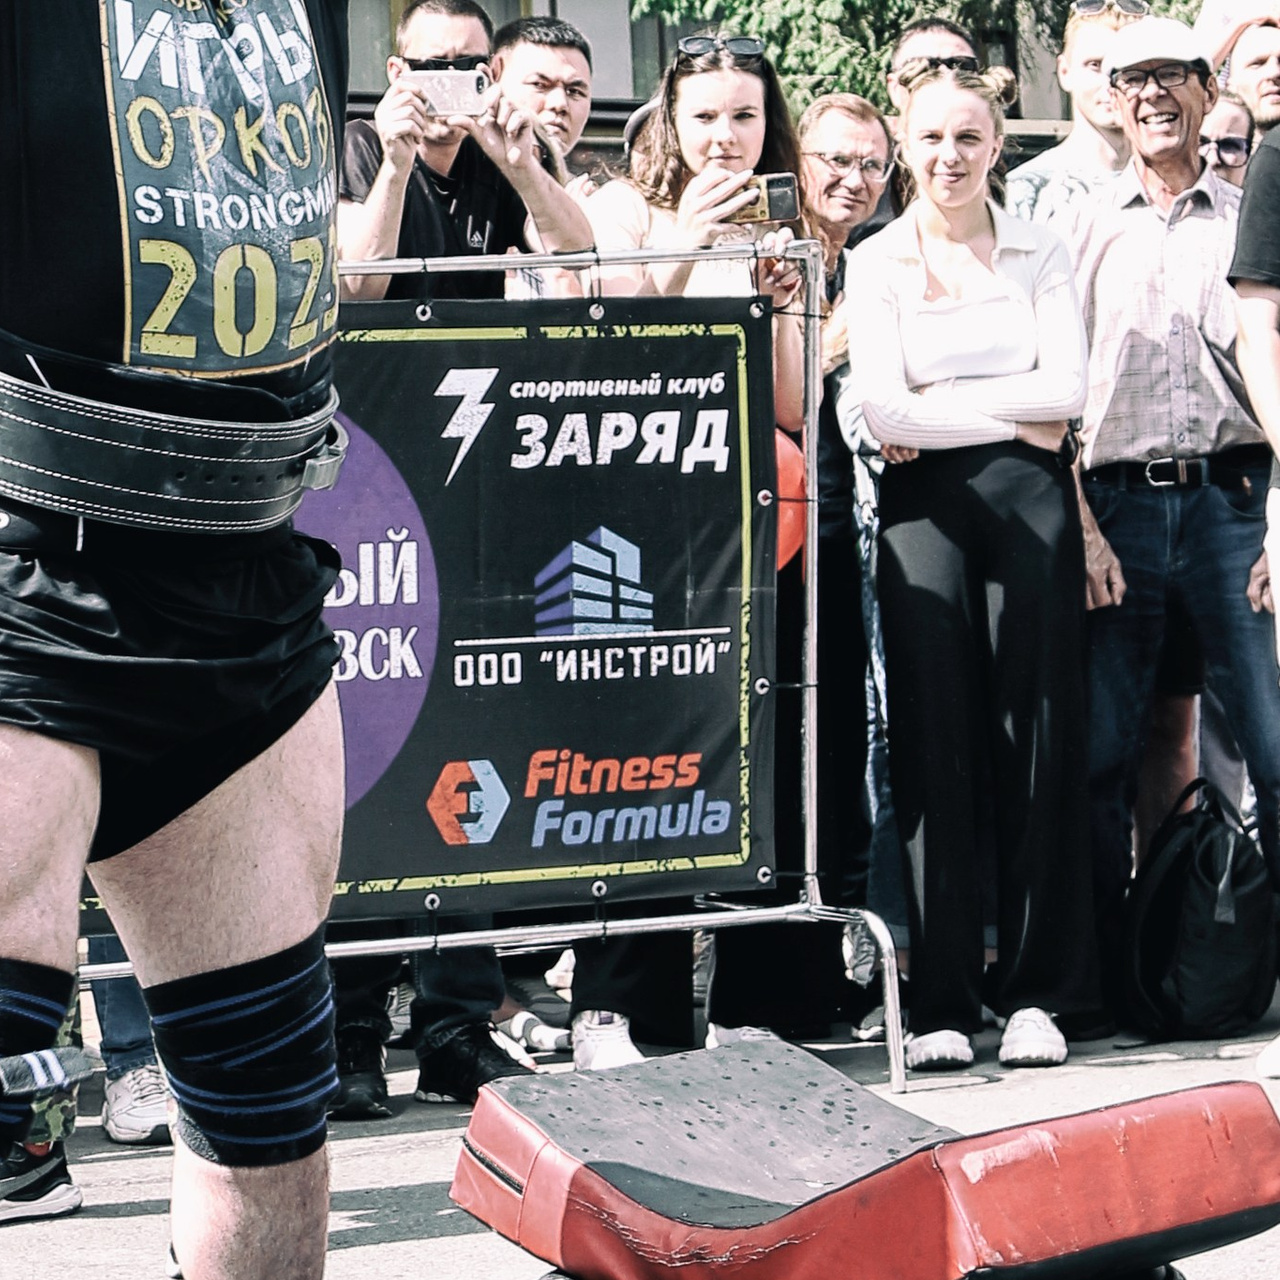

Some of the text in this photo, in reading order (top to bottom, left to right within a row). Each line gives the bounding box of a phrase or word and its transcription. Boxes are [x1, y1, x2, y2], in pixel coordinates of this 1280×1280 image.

[509, 372, 726, 403] спортивный клуб
[510, 409, 730, 474] ЗАРЯД
[453, 636, 732, 687] ООО "ИНСТРОЙ"
[524, 748, 703, 798] Fitness
[531, 789, 732, 847] Formula
